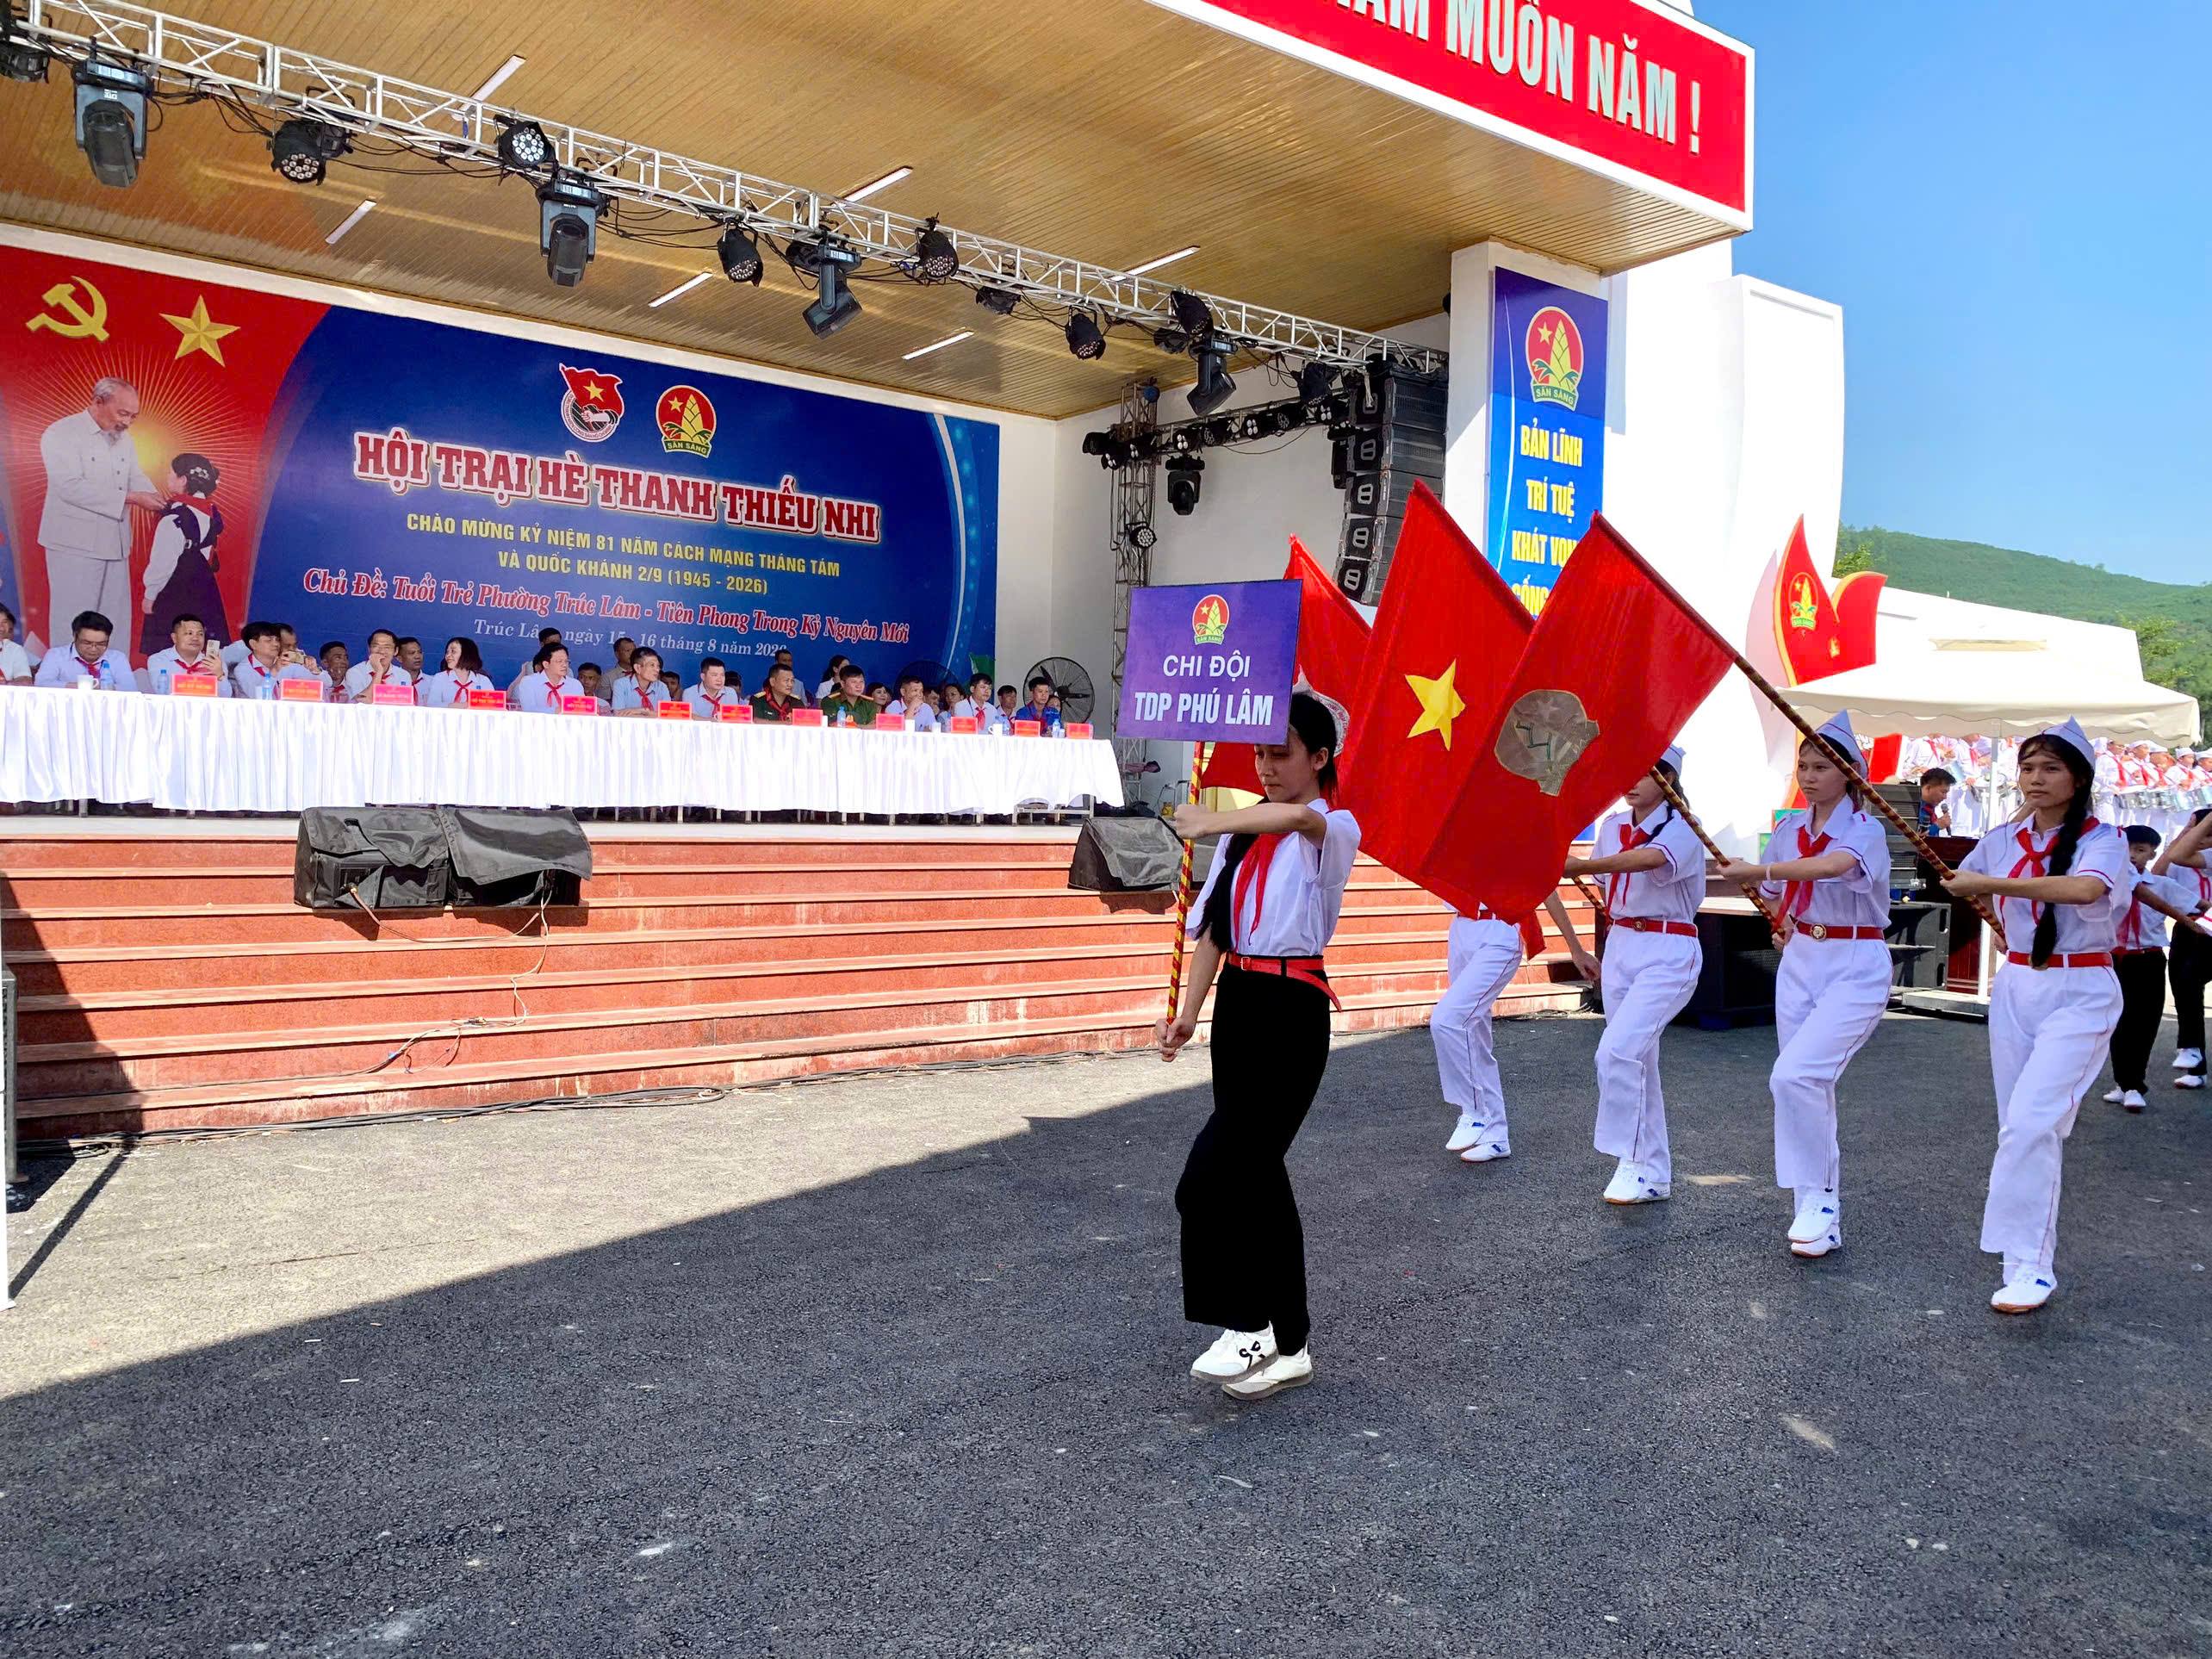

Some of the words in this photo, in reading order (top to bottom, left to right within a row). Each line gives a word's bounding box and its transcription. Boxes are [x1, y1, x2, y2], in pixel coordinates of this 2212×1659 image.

[1588, 33, 1677, 145] NĂM
[1690, 80, 1701, 155] !
[1519, 417, 1549, 461] BẢN
[1552, 427, 1583, 468] LĨNH
[356, 429, 427, 492] HỘI
[434, 444, 531, 503] TRẠI
[537, 451, 587, 503] HÈ
[593, 465, 715, 519] THANH
[721, 475, 817, 532] THIẾU
[823, 497, 879, 541] NHI
[1526, 475, 1548, 513] TRÍ
[1551, 482, 1575, 524] TUỆ
[407, 513, 456, 534] CHÀO
[462, 518, 514, 541] MỪNG
[520, 522, 543, 544] KỶ
[548, 528, 591, 550] NIỆM
[597, 536, 614, 551] 81
[621, 535, 658, 556] NĂM
[663, 541, 705, 562] CÁCH
[710, 548, 754, 568] MẠNG
[759, 552, 806, 573] THÁNG
[810, 558, 840, 577] TÁM
[1512, 526, 1548, 565] KHÁT
[498, 549, 520, 569] VÀ
[526, 552, 571, 574] QUỐC
[576, 558, 632, 580] KHÁNH
[638, 566, 662, 583] 2/9
[668, 569, 711, 588] (1945
[726, 575, 768, 594] 2026)
[304, 568, 347, 595] Chủ
[351, 567, 388, 599] Đề:
[393, 572, 437, 603] Tuổi
[441, 581, 474, 605] Trẻ
[478, 583, 551, 617] Phường
[555, 591, 596, 616] Trúc
[600, 595, 641, 620] Lâm
[657, 600, 694, 624] Tiên
[698, 605, 749, 633] Phong
[754, 610, 798, 637] Trong
[825, 616, 878, 643] Nguyên
[879, 621, 910, 643] Mới
[474, 619, 514, 637] Trúc
[518, 622, 539, 639] Lâ
[564, 630, 603, 645] ngày
[639, 633, 656, 648] 16
[661, 636, 705, 654] tháng
[708, 639, 717, 651] 8
[721, 642, 751, 656] năm
[1163, 655, 1202, 677] CHI
[1209, 649, 1251, 681] ĐỘI
[1134, 692, 1172, 722] TDP
[1177, 687, 1221, 724] PHÚ
[1225, 688, 1274, 726] LÂM
